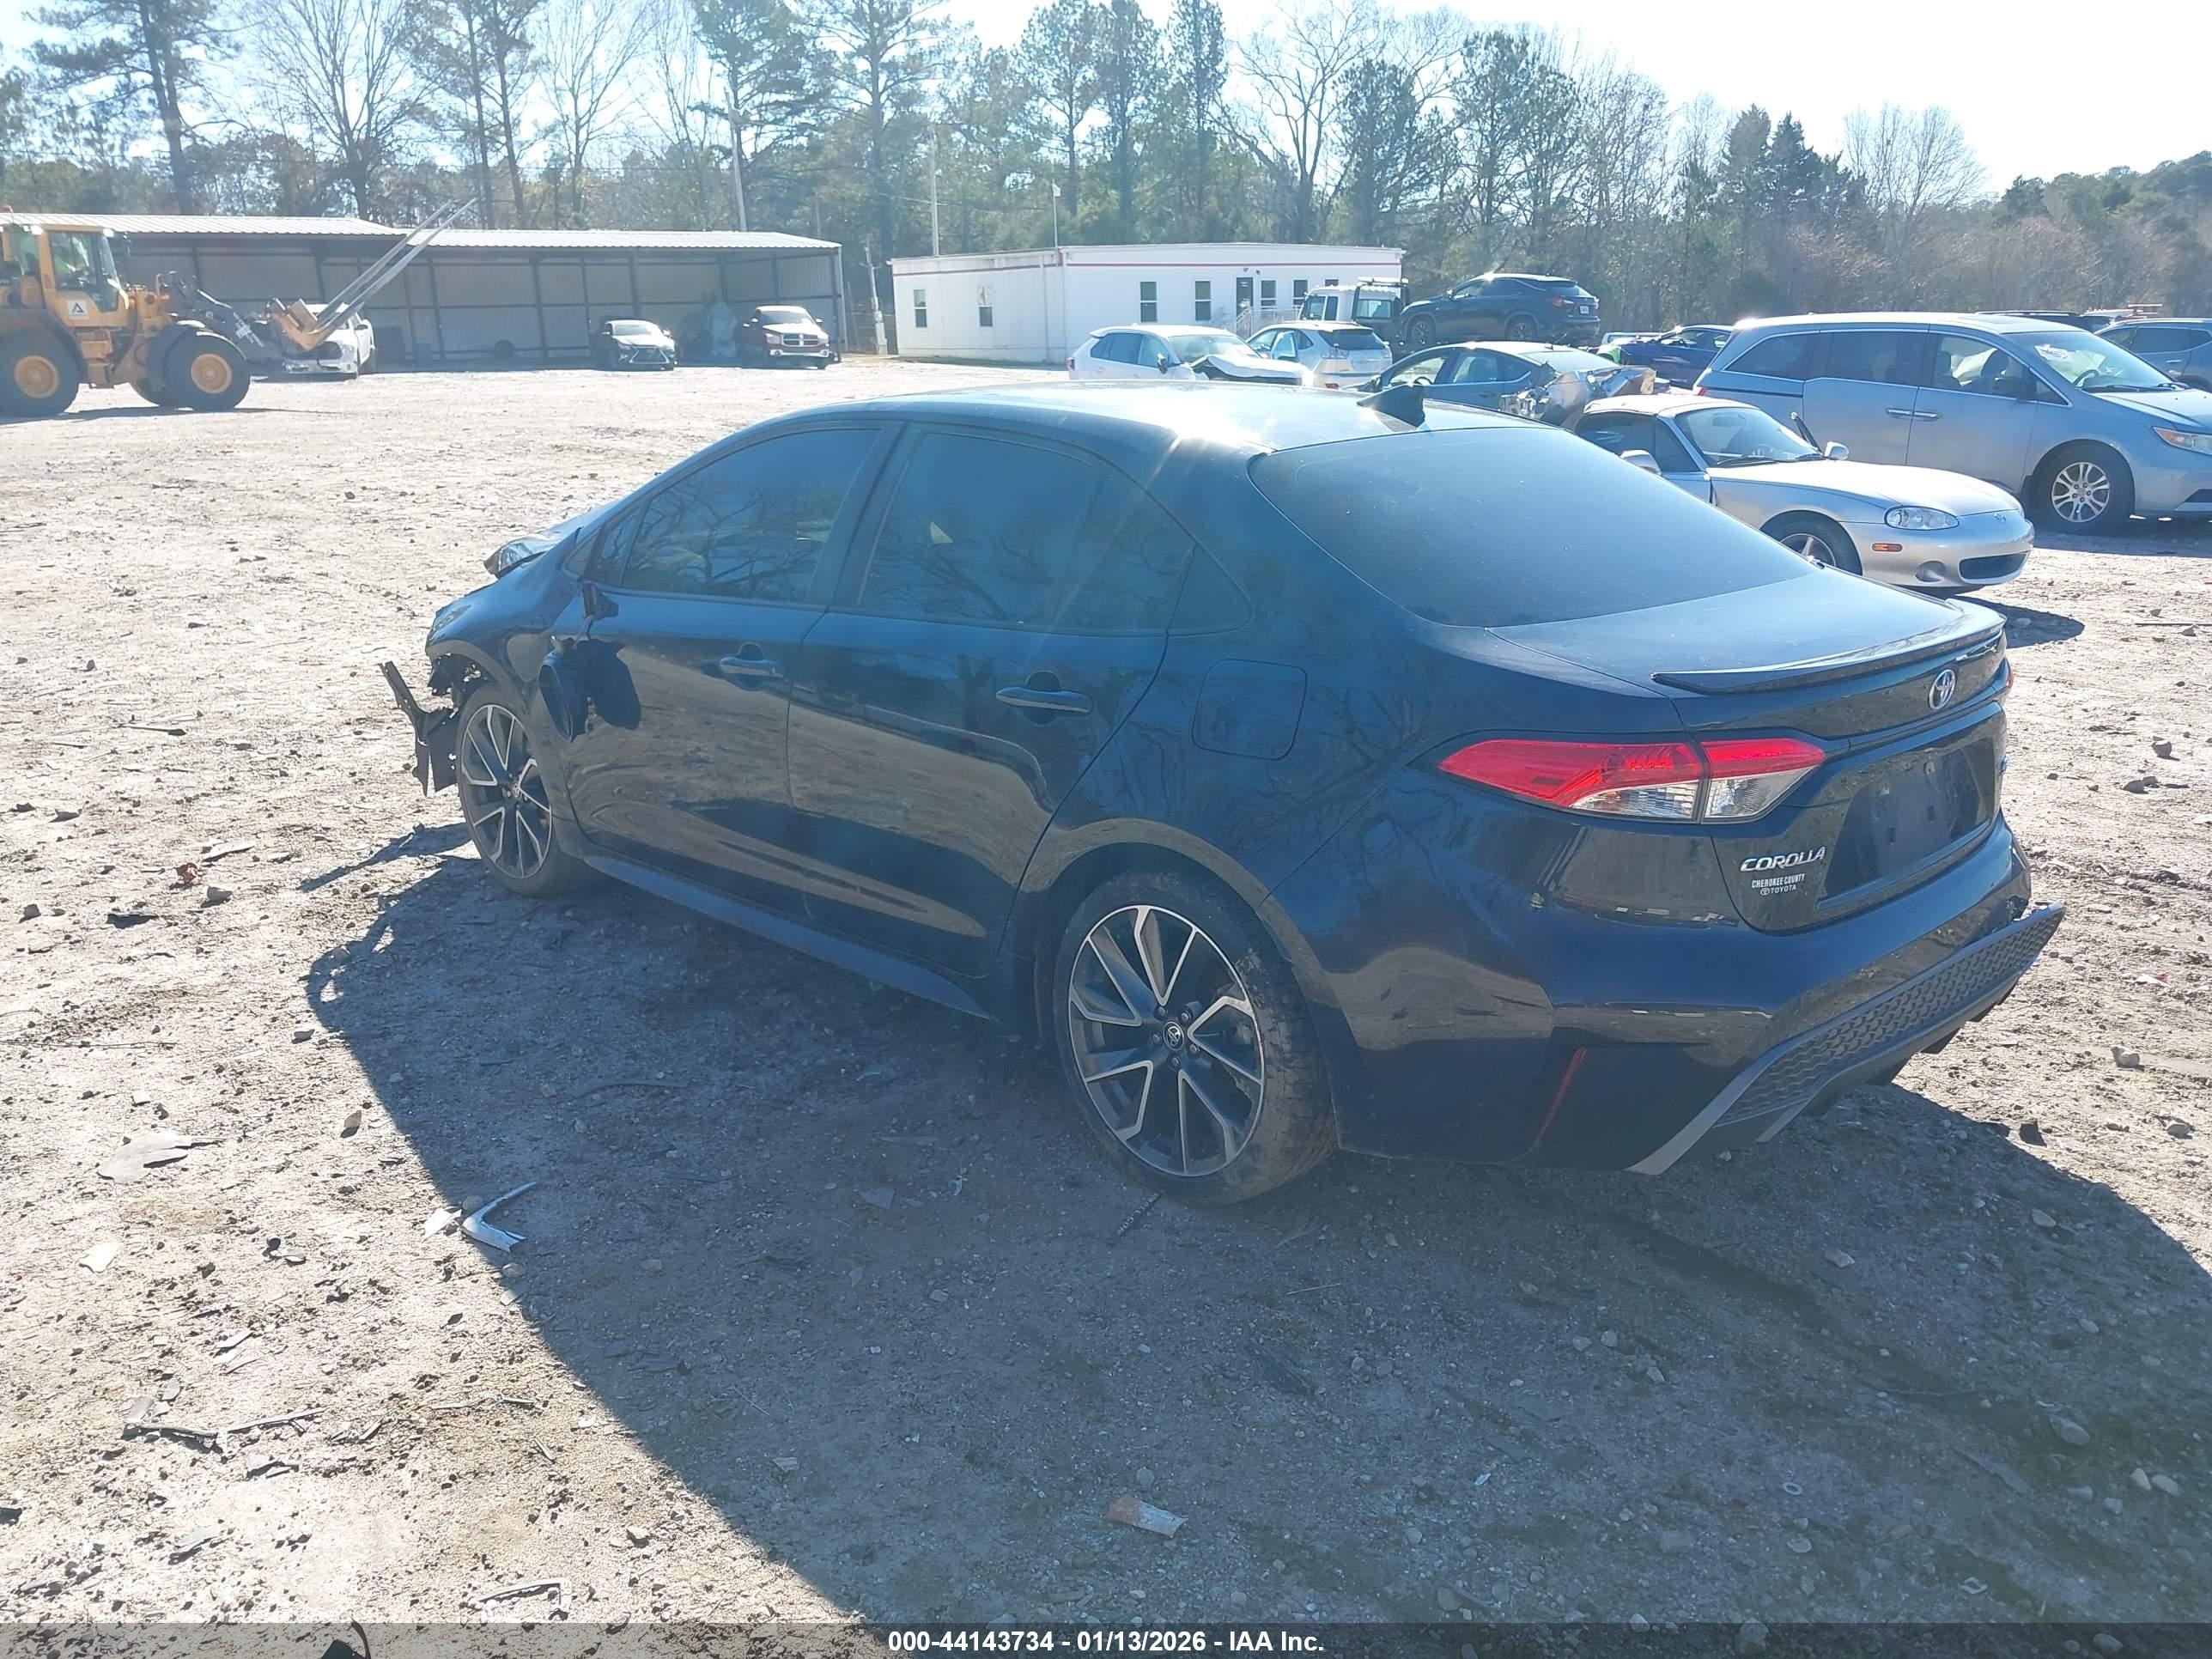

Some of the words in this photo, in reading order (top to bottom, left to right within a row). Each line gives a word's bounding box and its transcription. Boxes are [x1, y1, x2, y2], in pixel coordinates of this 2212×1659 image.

[1740, 846, 1826, 872] COROLLA
[1751, 875, 1784, 889] CHEROKEE
[1784, 873, 1806, 885] COUNTY
[1770, 884, 1796, 895] TOYOTA
